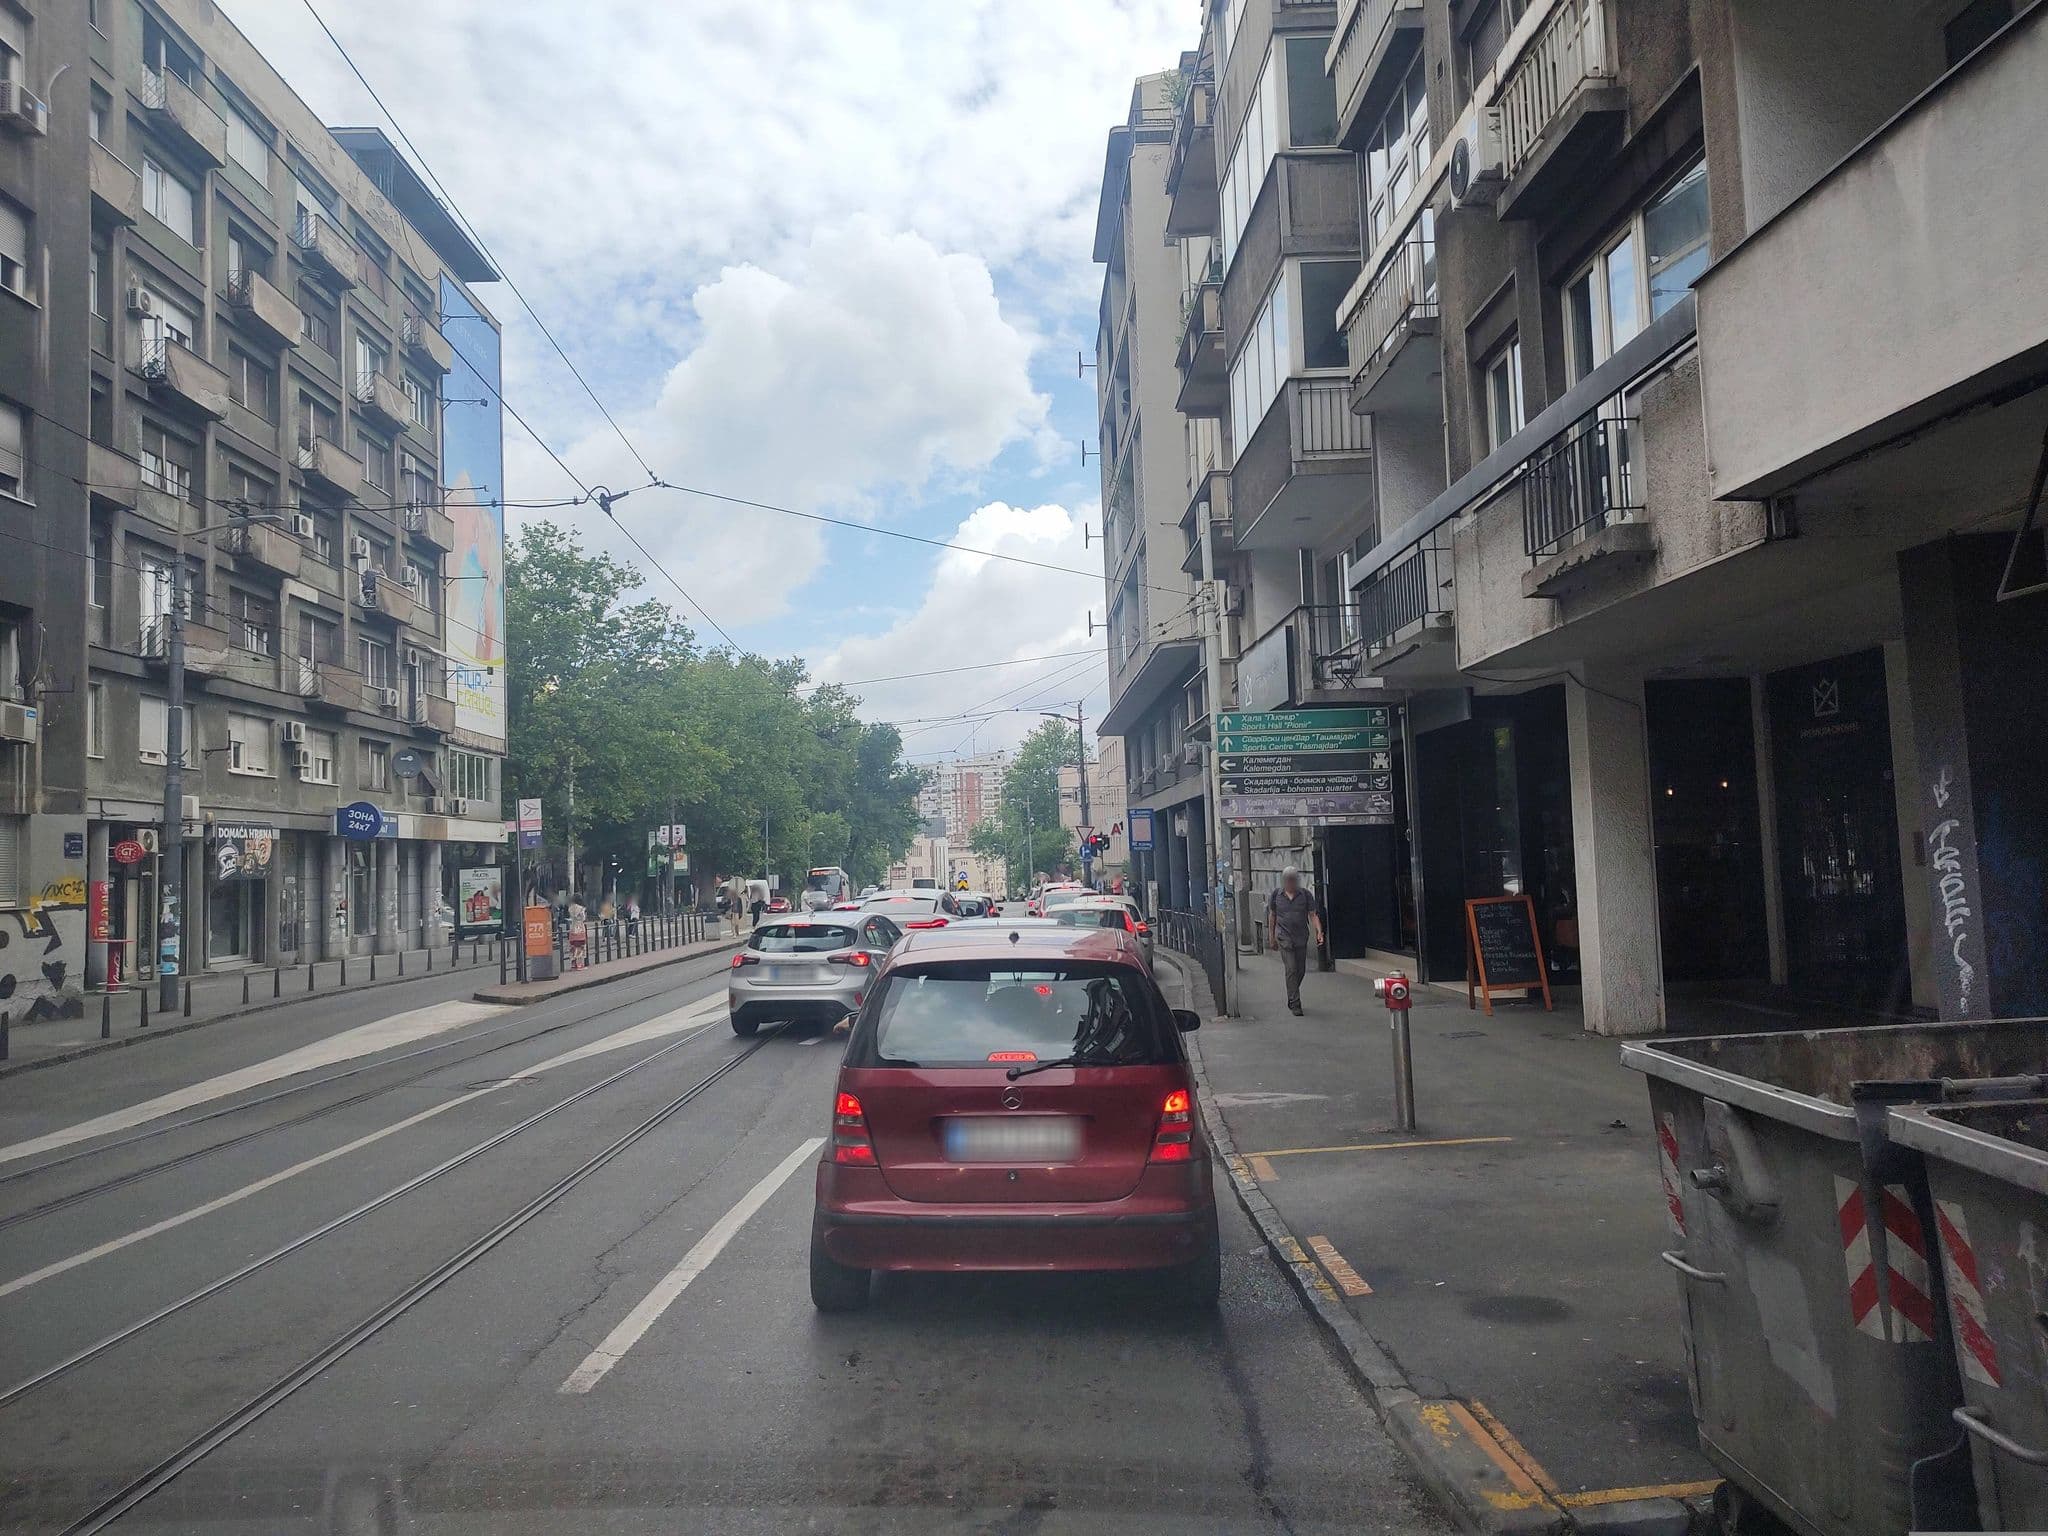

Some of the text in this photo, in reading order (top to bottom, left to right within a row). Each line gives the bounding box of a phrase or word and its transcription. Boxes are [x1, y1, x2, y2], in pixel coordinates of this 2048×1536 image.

[1242, 714, 1262, 722] Хала
[1242, 723, 1266, 731] Sports
[1242, 744, 1267, 752] Sports
[1243, 756, 1292, 764] Калемегдан
[1243, 765, 1291, 773] Kalemegdan
[1243, 778, 1288, 786] Скадарлија
[1244, 786, 1280, 795] Skadarlija
[1287, 784, 1324, 793] bohemian
[1325, 785, 1353, 793] quarter
[348, 809, 375, 822] ЗОНА
[348, 820, 371, 832] 24x7
[218, 825, 272, 839] DOMAĆA HRANA
